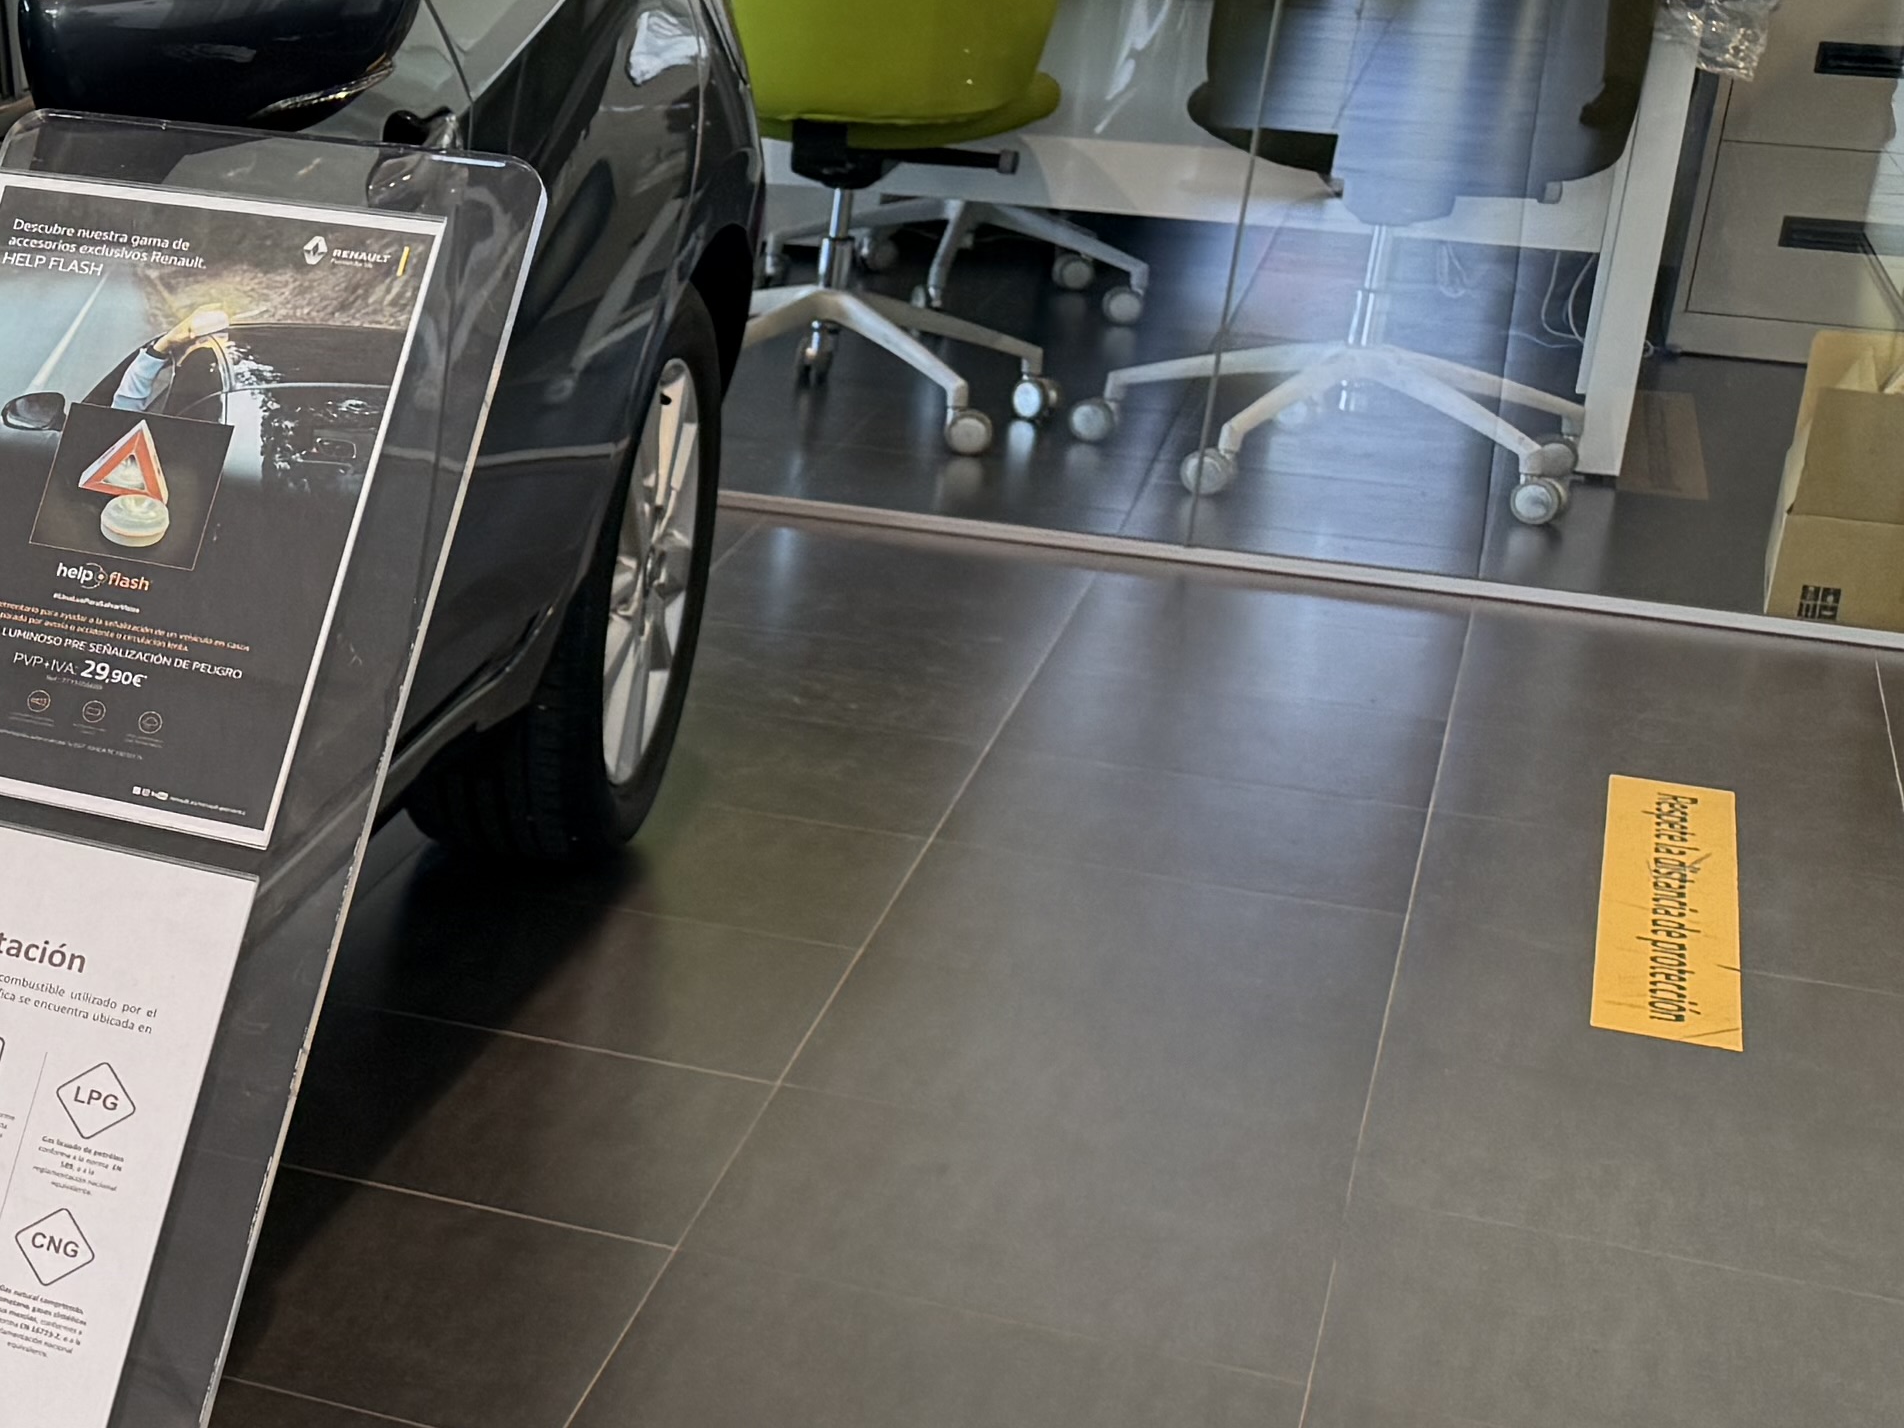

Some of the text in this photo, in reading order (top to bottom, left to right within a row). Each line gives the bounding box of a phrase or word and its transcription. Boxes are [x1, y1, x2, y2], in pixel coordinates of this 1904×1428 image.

[12, 218, 190, 251] Descubre nuestra gama de
[1, 251, 104, 276] HELP FLASH
[8, 236, 207, 269] accesorios exclusivos Renault.
[332, 248, 392, 263] RENAULT
[56, 562, 94, 584] help
[108, 571, 150, 591] flash
[1, 627, 63, 646] LUMINOSO
[63, 638, 88, 651] PRE
[88, 642, 172, 666] SEÑALIZACIÓN
[173, 657, 191, 670] DE
[191, 661, 243, 679] PELIGRO
[1635, 791, 1702, 1023] Respete la distancia de protección
[18, 995, 32, 1005] se
[33, 999, 89, 1020] encuentra
[92, 1012, 135, 1031] ubicada
[137, 1024, 152, 1035] en
[70, 991, 118, 1010] utilizado
[121, 1003, 142, 1015] por
[146, 1008, 158, 1018] el
[73, 1085, 119, 1111] LPG
[31, 1231, 80, 1258] CNG
